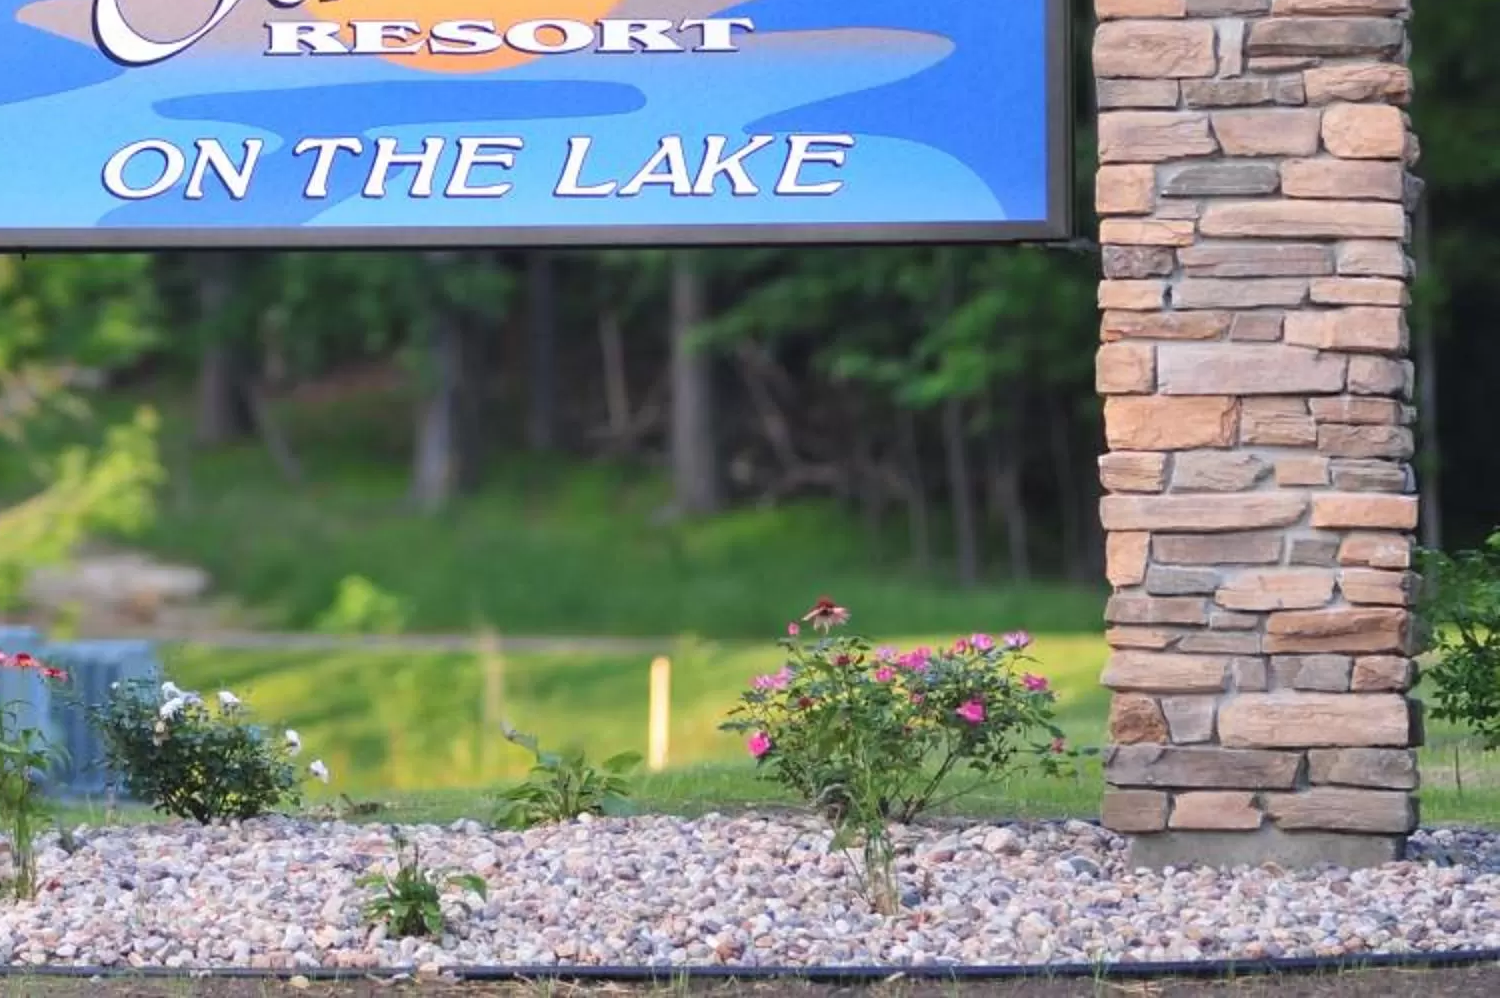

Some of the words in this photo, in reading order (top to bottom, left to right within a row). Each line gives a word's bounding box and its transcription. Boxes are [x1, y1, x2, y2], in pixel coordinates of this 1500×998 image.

[264, 16, 754, 57] RESORT
[101, 137, 265, 200] ON
[292, 135, 524, 199] THE
[552, 133, 857, 198] LAKE
